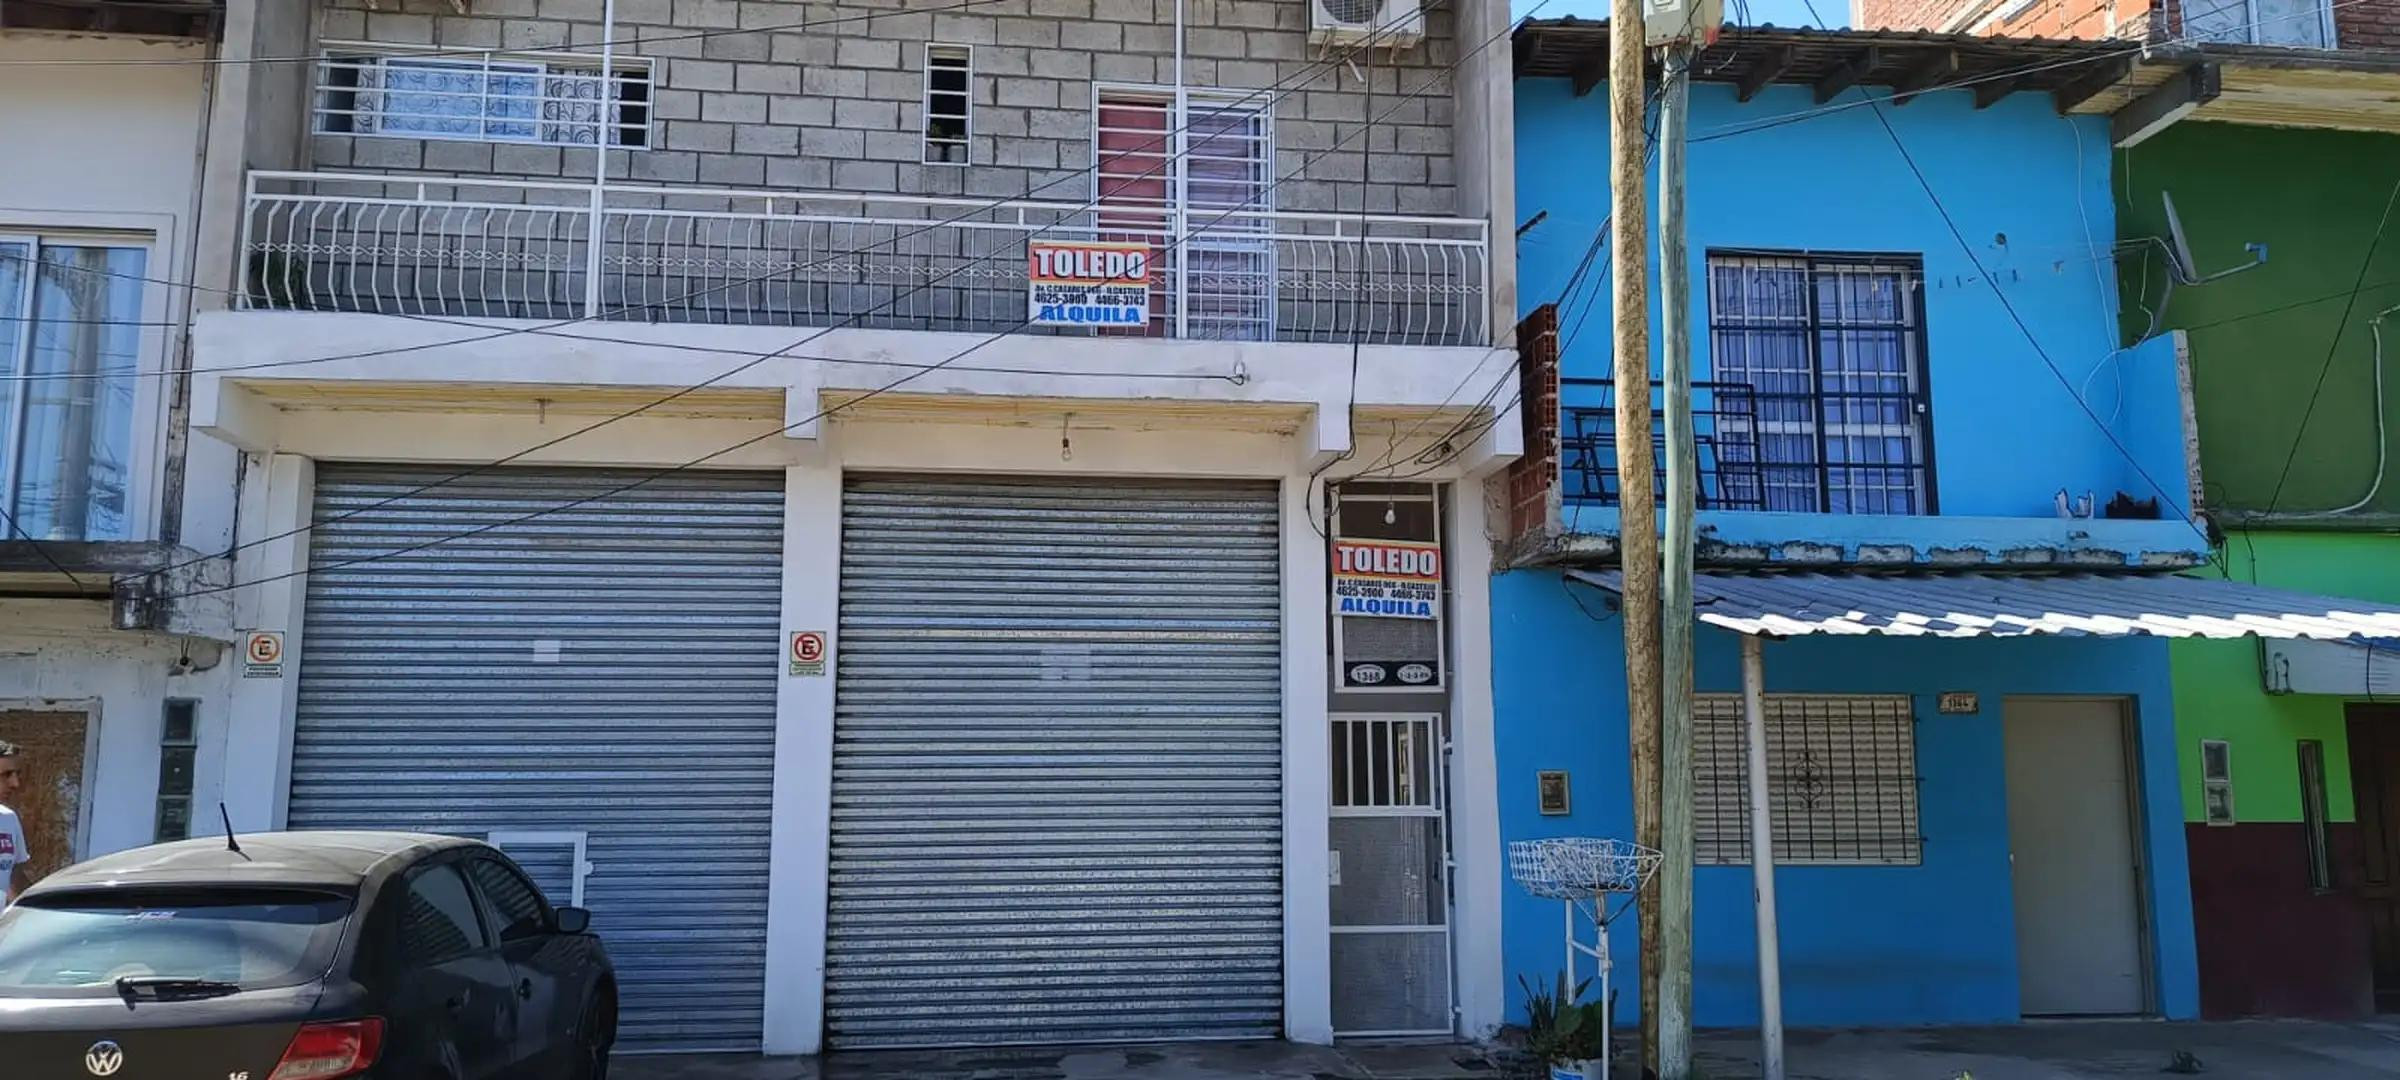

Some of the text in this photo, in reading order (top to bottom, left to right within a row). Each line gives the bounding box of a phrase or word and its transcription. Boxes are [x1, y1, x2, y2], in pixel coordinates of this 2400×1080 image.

[1033, 249, 1145, 279] TOLEDO
[1040, 305, 1140, 322] ALQUILA
[1337, 547, 1437, 576] TOLEDO
[1340, 598, 1430, 616] ALQUILA
